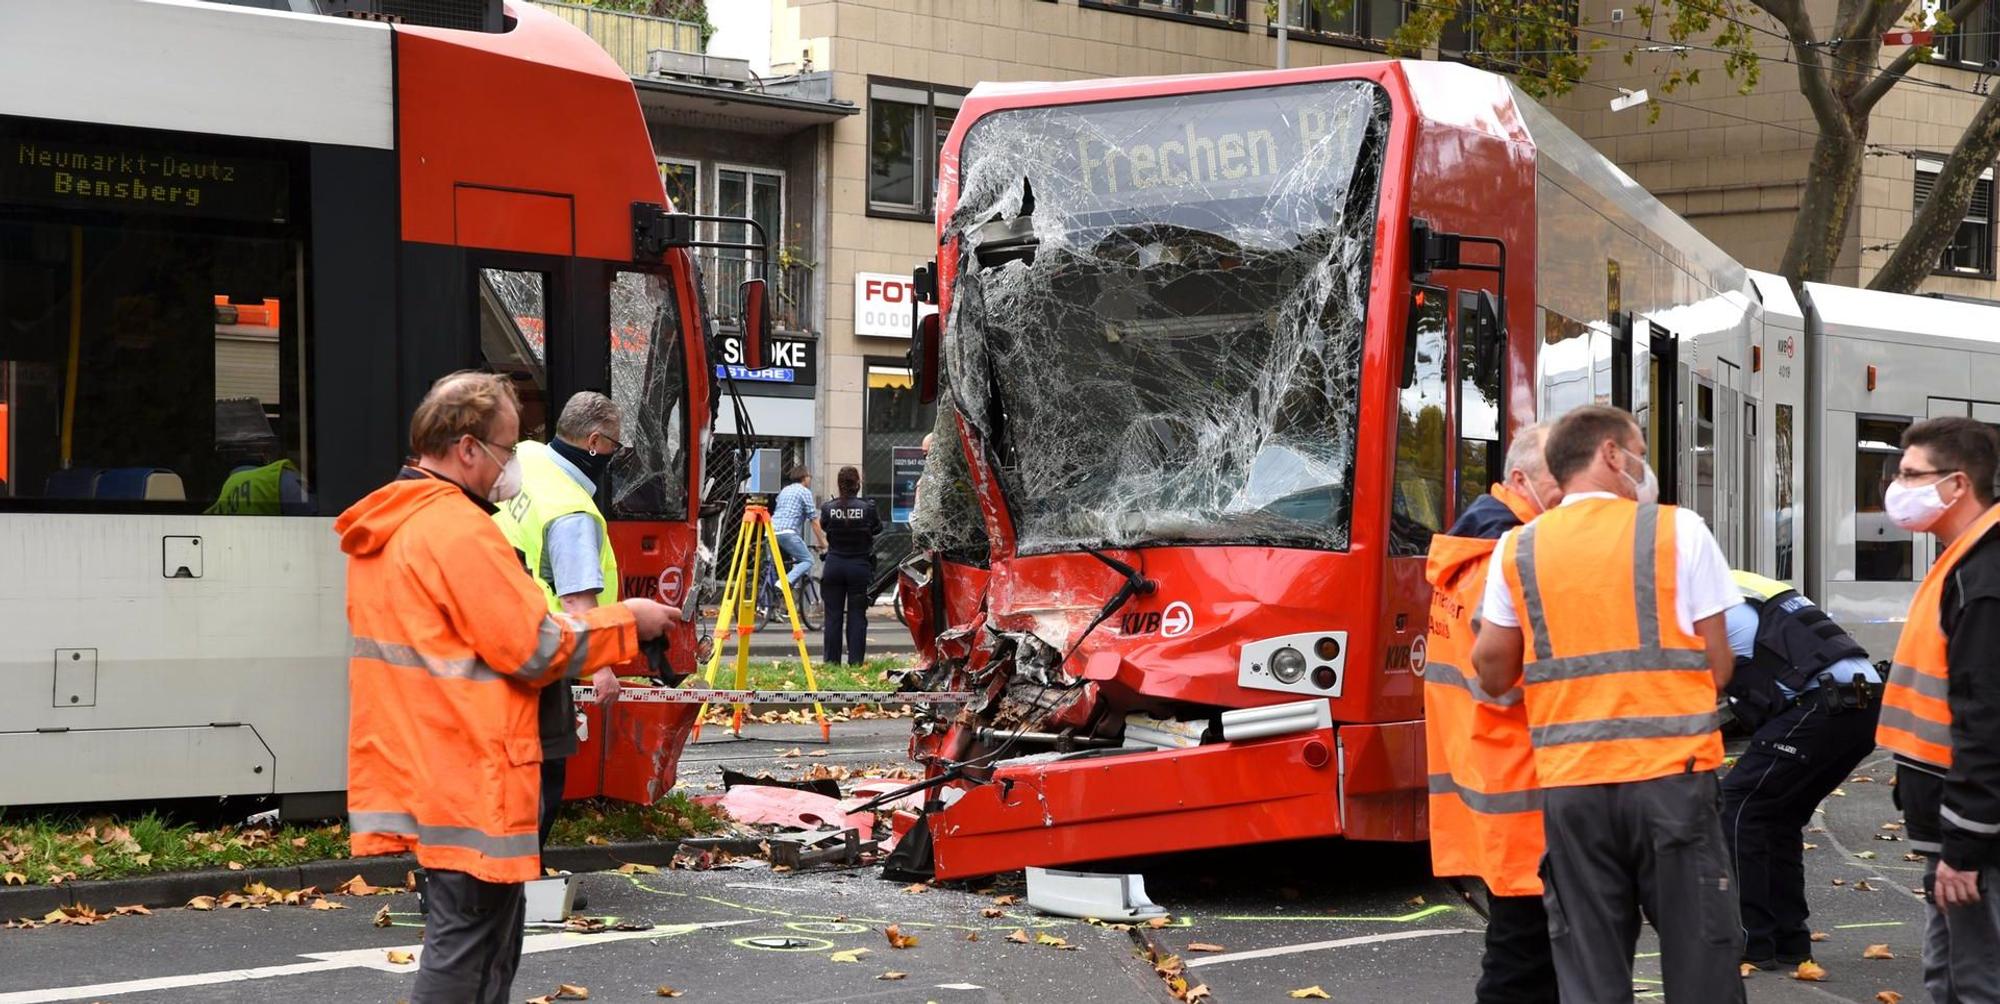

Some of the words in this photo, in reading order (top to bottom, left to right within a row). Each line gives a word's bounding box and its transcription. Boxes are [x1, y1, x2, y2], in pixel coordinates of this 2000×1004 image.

[18, 143, 235, 182] Neumarkt-Deutz
[1078, 122, 1280, 193] Frechen
[54, 171, 201, 207] Bensberg
[866, 280, 915, 304] FOT
[723, 338, 806, 367] SKE
[830, 508, 864, 519] POLIZEI
[624, 576, 658, 599] KVB
[1120, 611, 1161, 635] KVB
[1385, 645, 1411, 670] KVB
